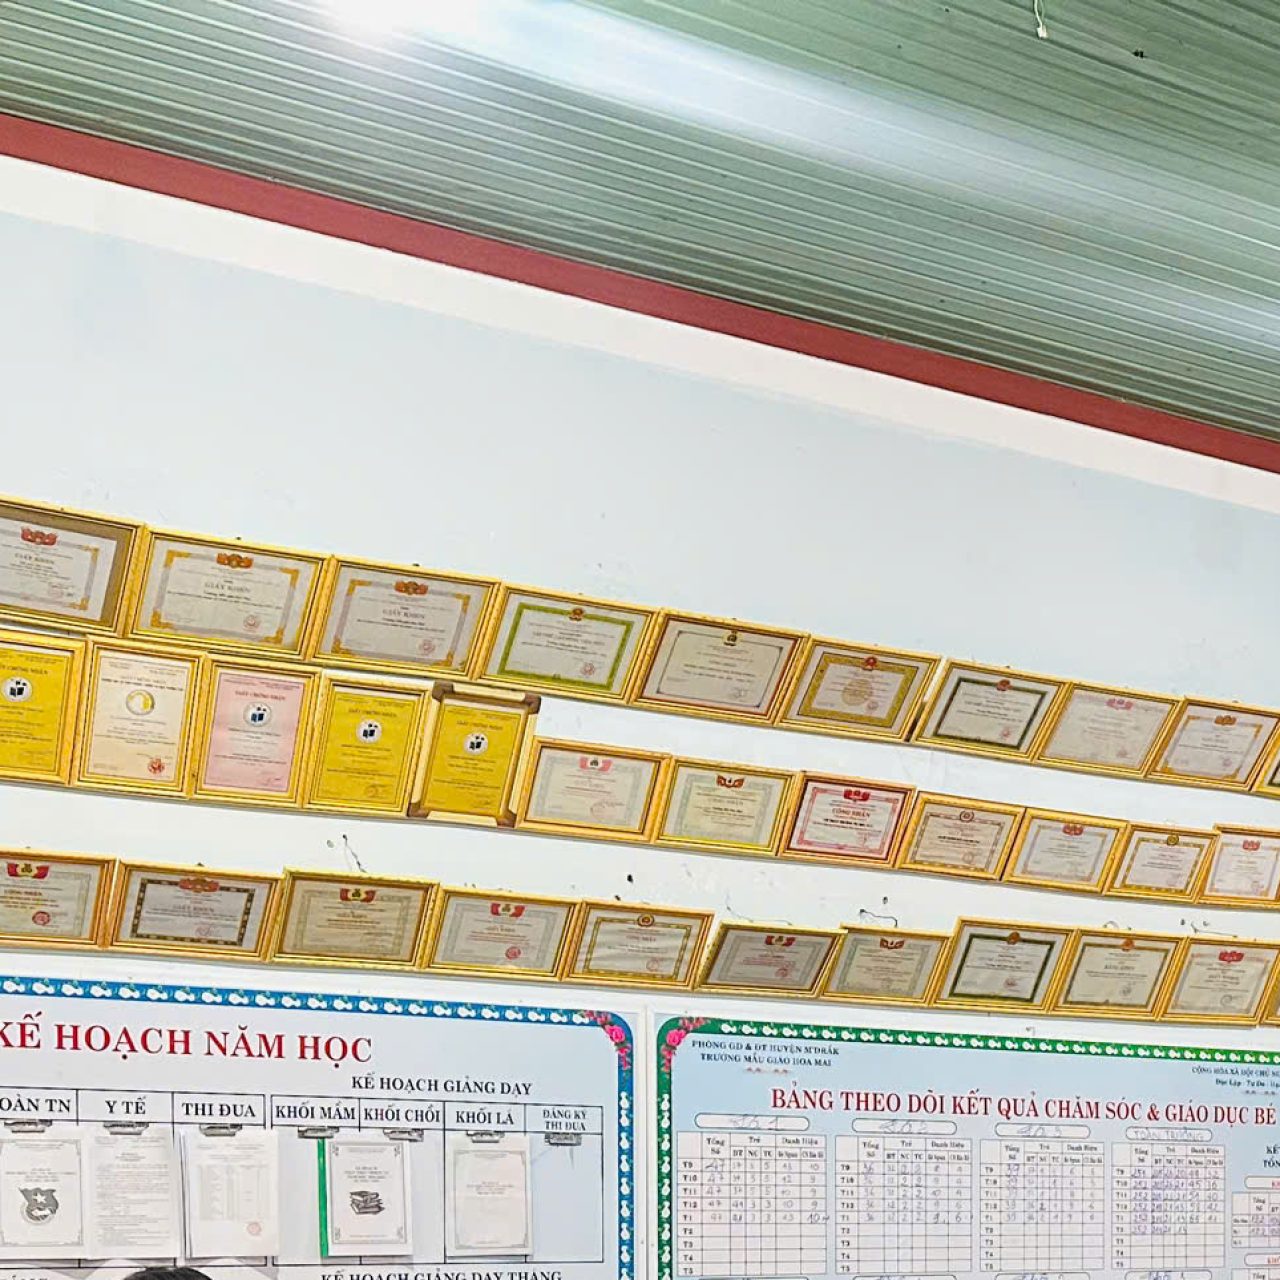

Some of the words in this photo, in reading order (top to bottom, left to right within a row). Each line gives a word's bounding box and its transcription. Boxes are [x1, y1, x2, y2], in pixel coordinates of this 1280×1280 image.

[55, 1023, 192, 1060] HOẠCH
[205, 1025, 286, 1059] NĂM
[297, 1035, 373, 1068] HỌC
[728, 1042, 743, 1051] GD
[745, 1043, 752, 1051] &
[770, 1044, 802, 1055] HUYỆN
[792, 1057, 813, 1066] HOA
[814, 1058, 832, 1067] MAI
[352, 1072, 374, 1090] KẾ
[379, 1078, 439, 1095] HOẠCH
[443, 1075, 496, 1094] GIẢNG
[500, 1082, 533, 1097] DẠY
[45, 1097, 71, 1114] TN
[106, 1101, 118, 1114] Y
[122, 1096, 147, 1115] TẾ
[182, 1103, 214, 1117] THI
[219, 1104, 257, 1119] ĐUA
[275, 1101, 316, 1119] KHỐI
[319, 1099, 356, 1120] MẦM
[364, 1103, 401, 1121] KHỐI
[404, 1105, 441, 1123] CHỒI
[772, 1080, 833, 1111] BẢNG
[840, 1090, 901, 1113] THEO
[907, 1090, 946, 1114] DÕI
[952, 1089, 993, 1116] KẾT
[998, 1090, 1039, 1120] QUẢ
[1045, 1095, 1100, 1119] CHĂM
[1105, 1097, 1142, 1121] SÓC
[1147, 1105, 1160, 1121] &
[1165, 1099, 1209, 1124] GIÁO
[1214, 1105, 1250, 1129] DỤC
[1254, 1103, 1278, 1125] BÉ
[455, 1106, 493, 1125] KHỐI
[495, 1110, 515, 1125] LÁ
[545, 1121, 562, 1130] THI
[564, 1121, 586, 1131] ĐUA
